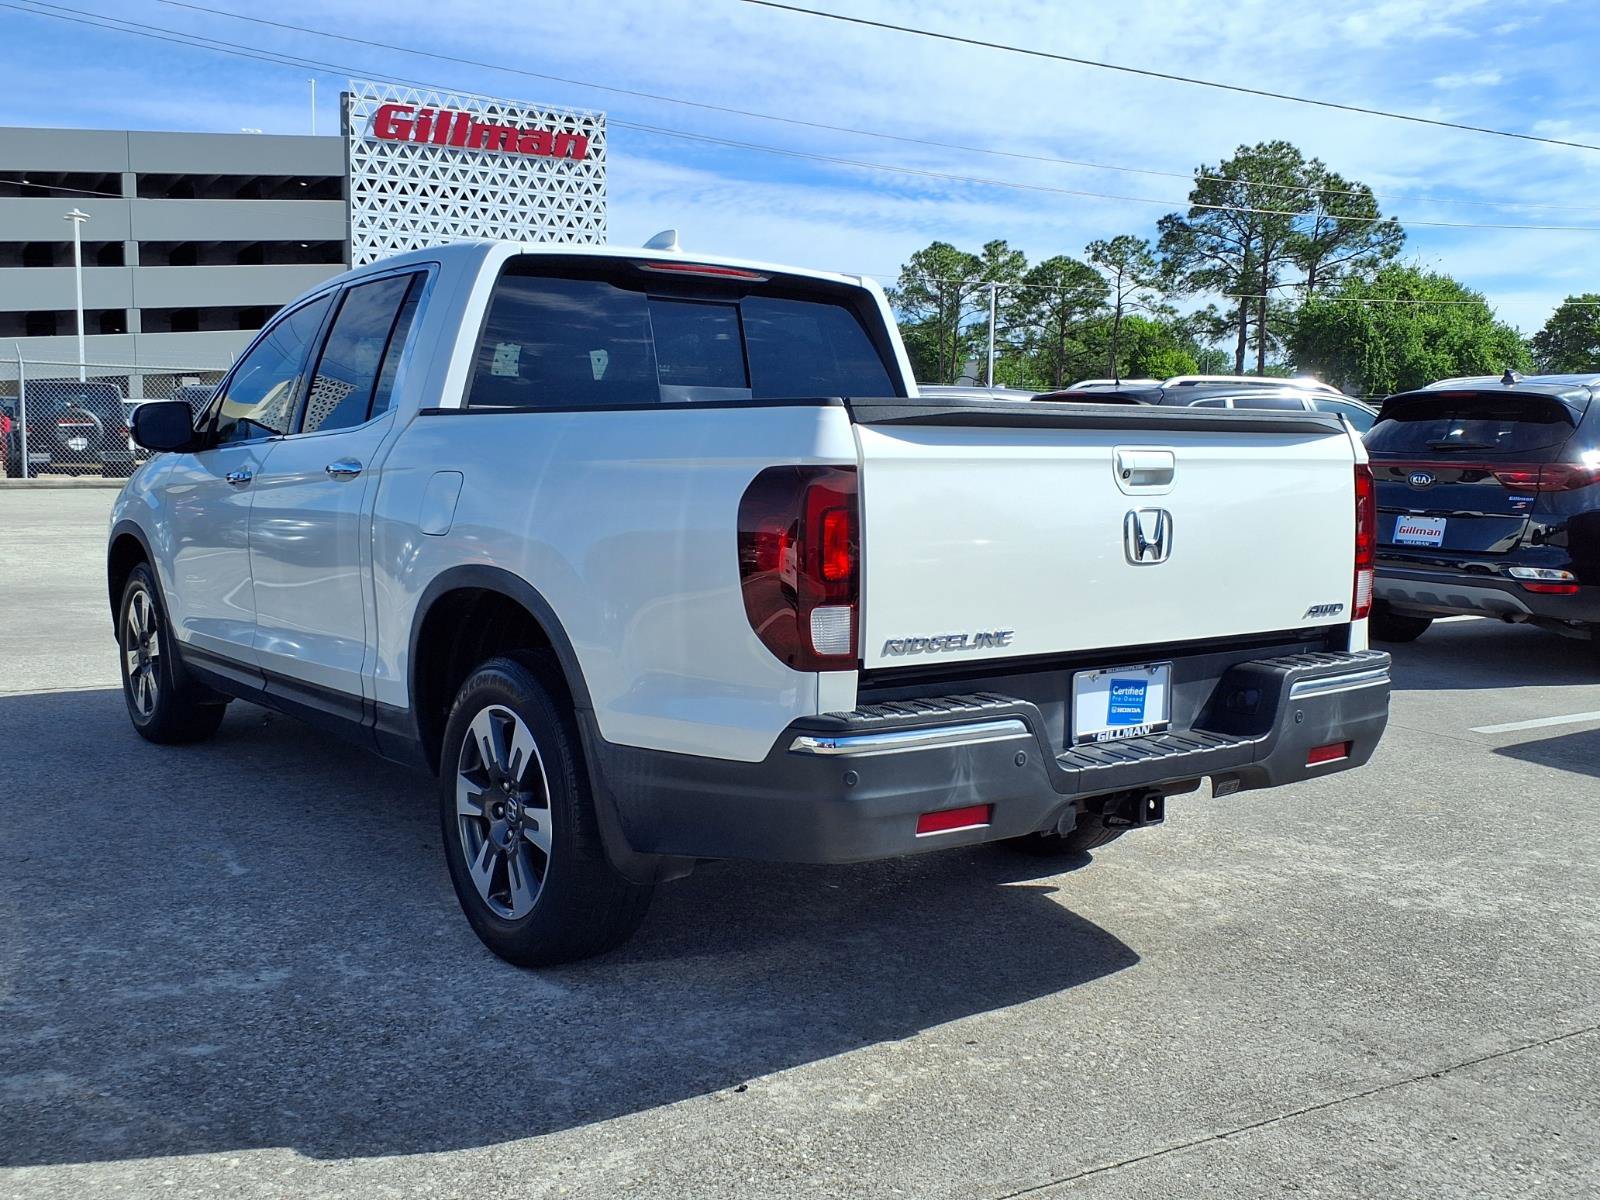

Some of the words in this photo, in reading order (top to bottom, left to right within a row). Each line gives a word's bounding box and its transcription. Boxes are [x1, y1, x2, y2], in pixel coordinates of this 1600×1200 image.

[373, 103, 590, 160] Gillman
[1412, 475, 1428, 484] KIA
[1399, 526, 1441, 536] Gillman
[1301, 603, 1344, 620] AWD
[880, 630, 1015, 658] RIDGELINE
[1112, 685, 1145, 696] Certified
